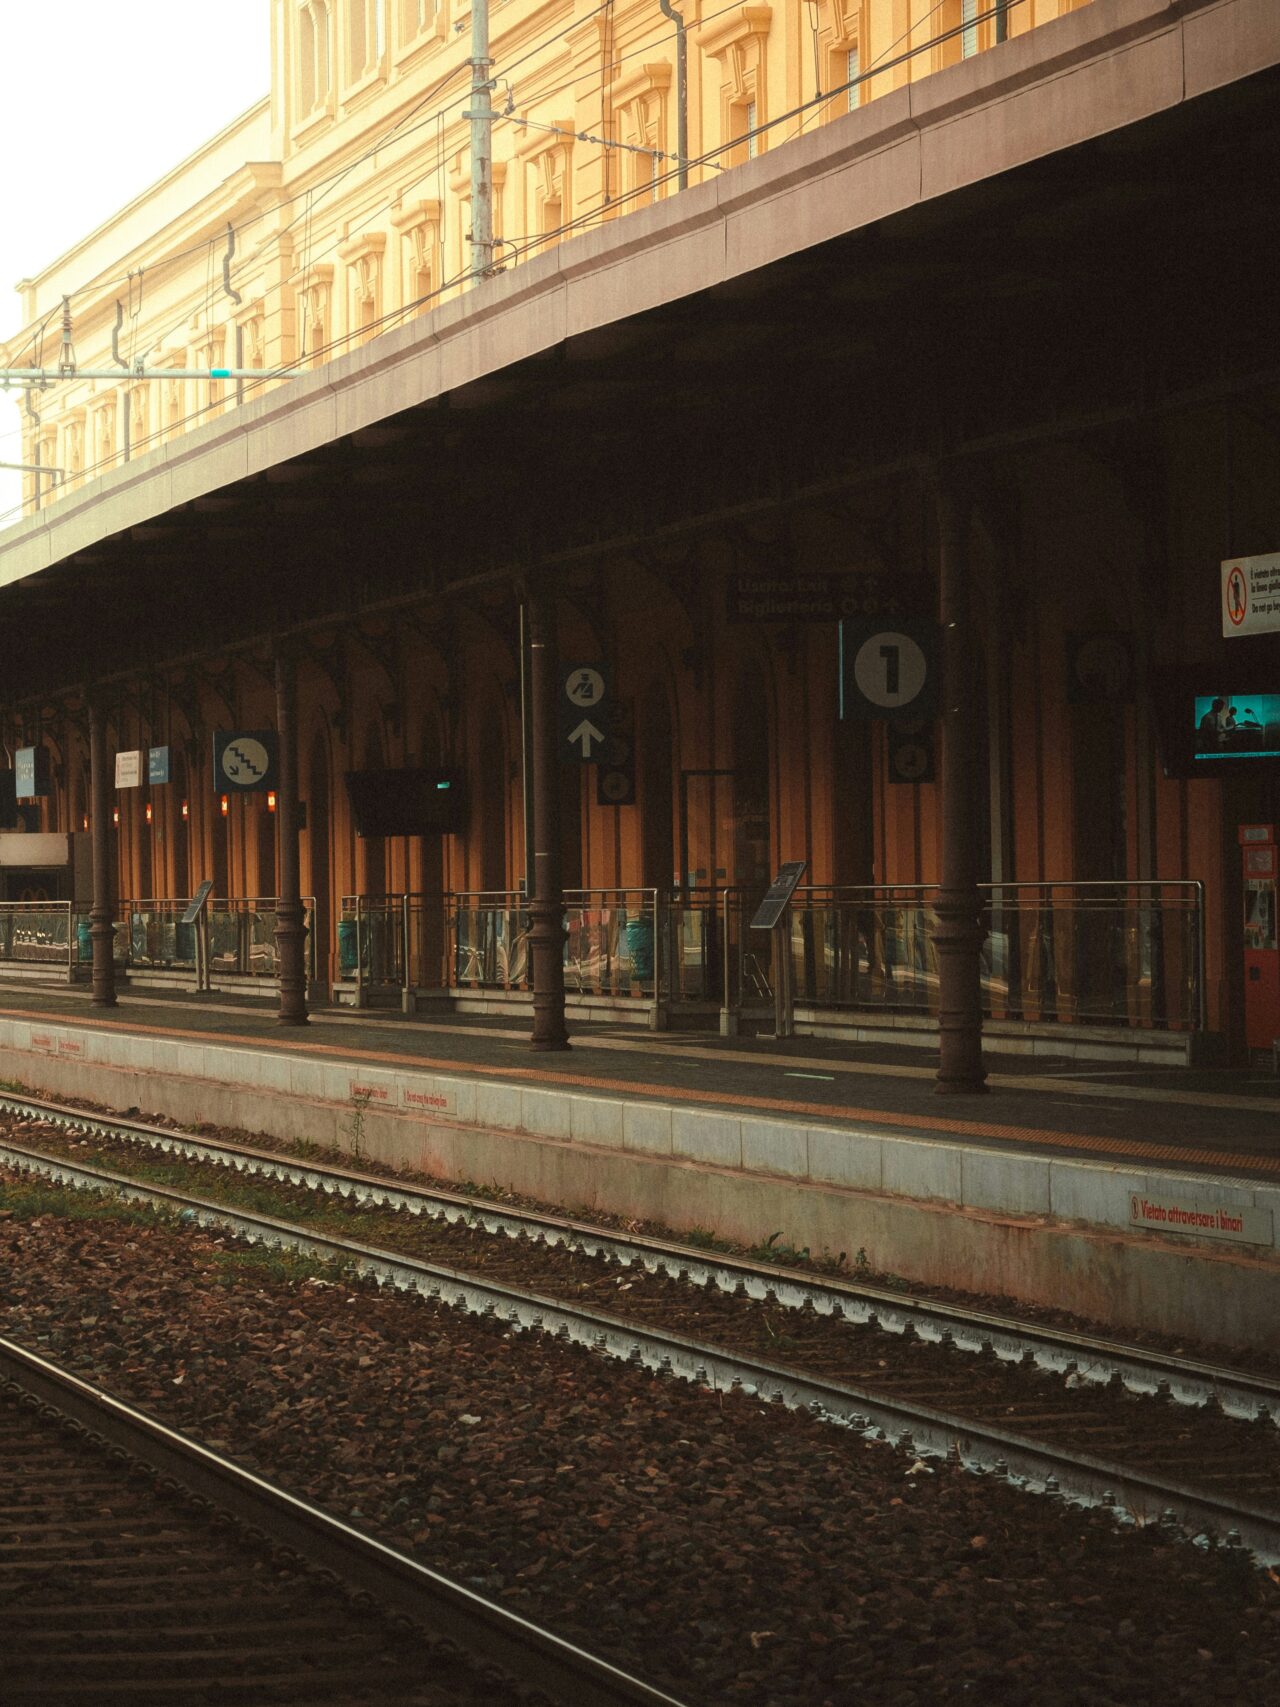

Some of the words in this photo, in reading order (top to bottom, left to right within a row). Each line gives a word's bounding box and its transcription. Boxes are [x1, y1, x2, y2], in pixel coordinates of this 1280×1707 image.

[880, 645, 899, 694] 1
[1141, 1200, 1167, 1221] Vietato
[1168, 1206, 1215, 1229] attraversare
[1220, 1209, 1243, 1232] binari
